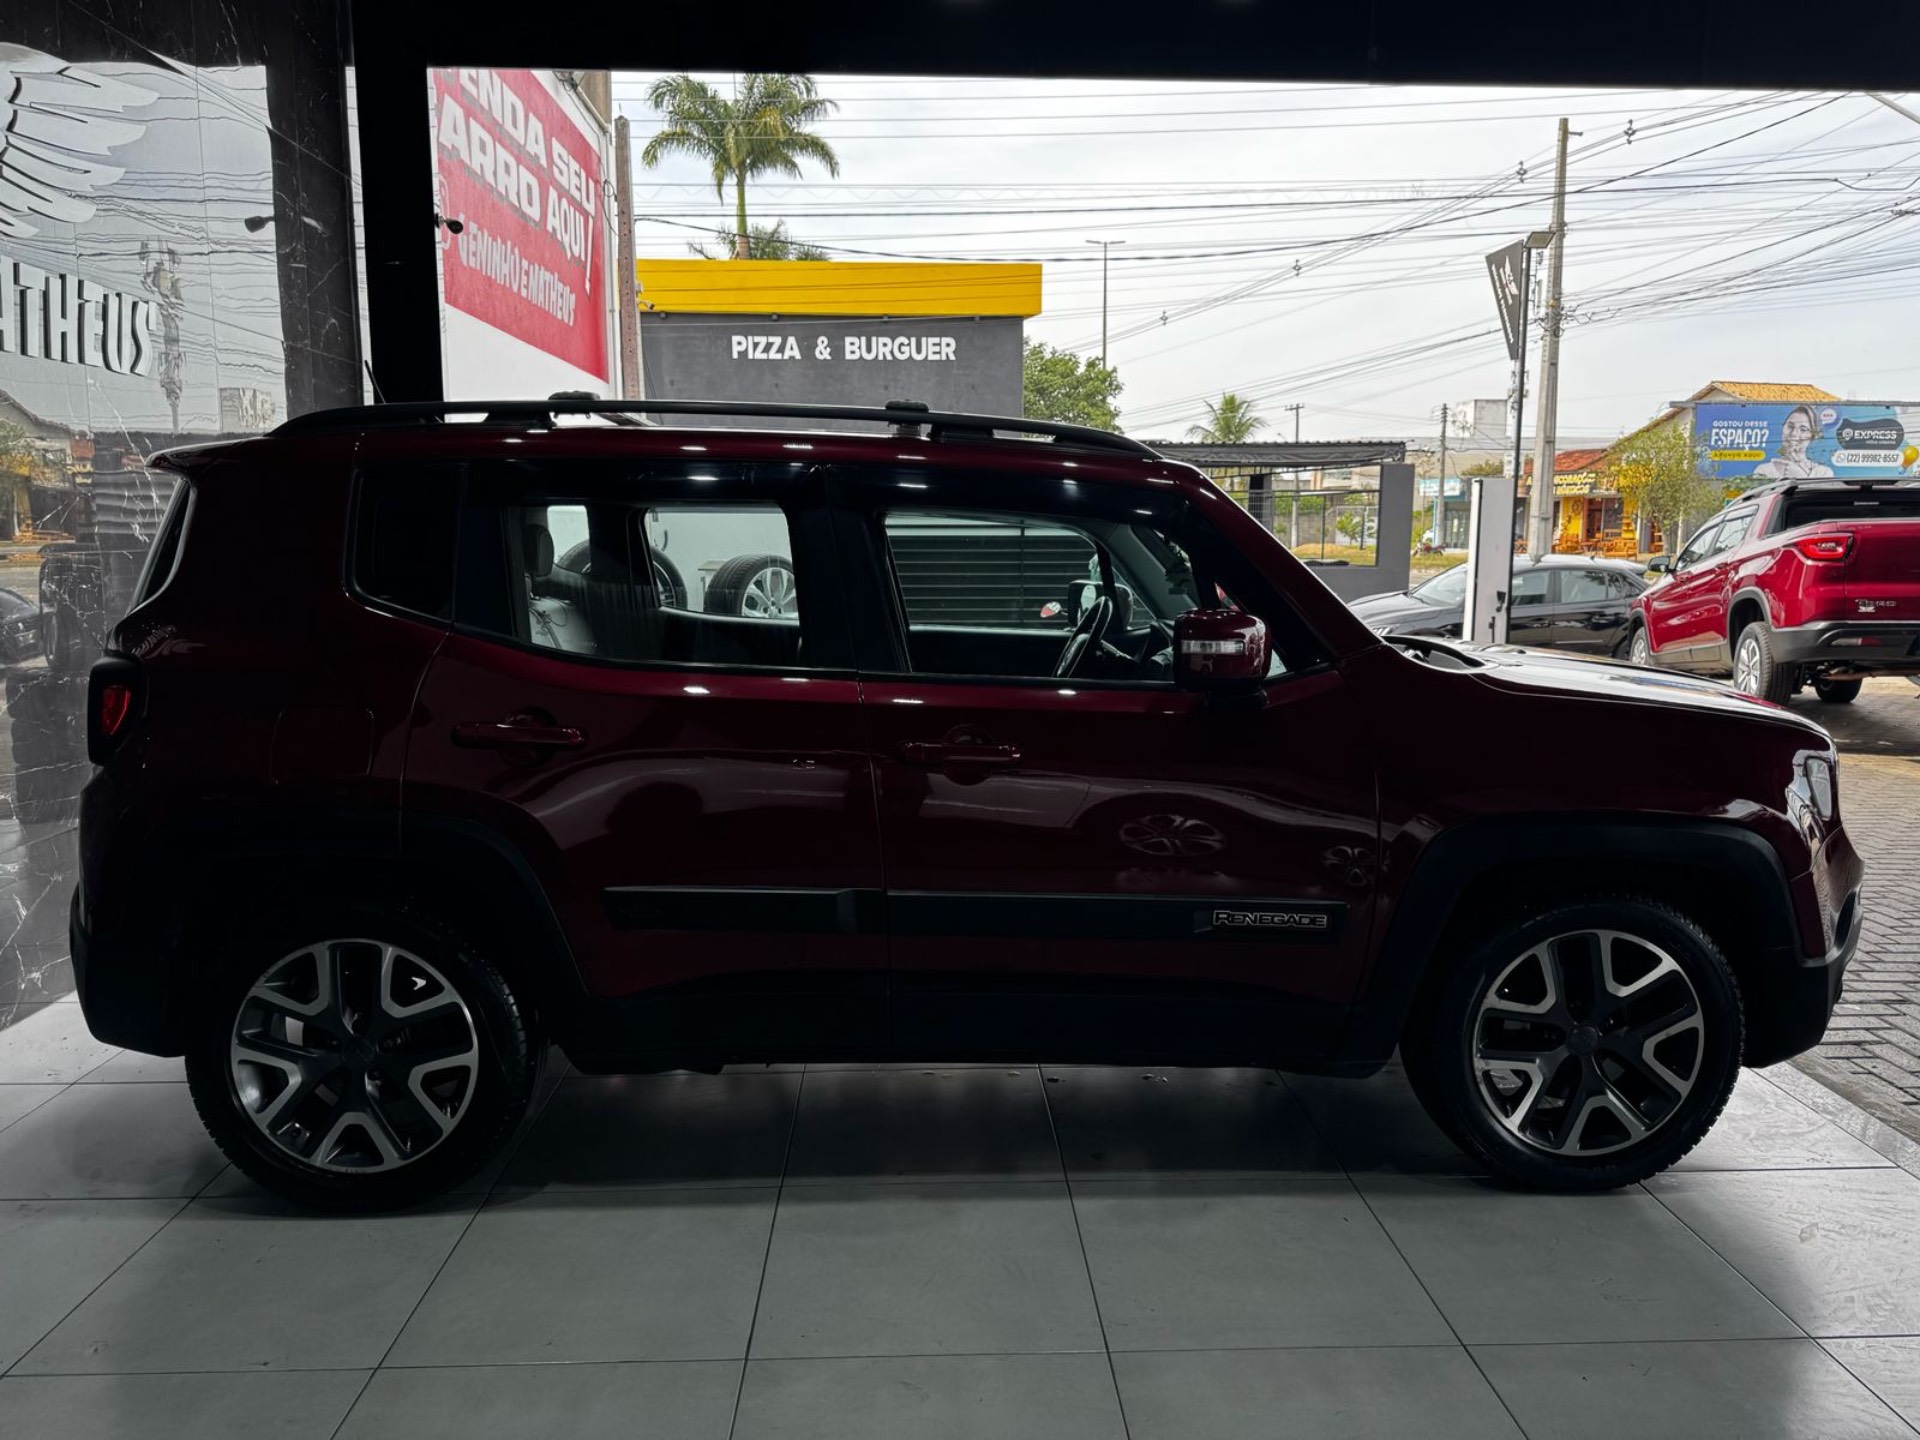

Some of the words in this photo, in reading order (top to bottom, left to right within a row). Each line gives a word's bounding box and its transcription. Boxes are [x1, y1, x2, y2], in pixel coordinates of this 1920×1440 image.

[551, 137, 596, 217] SEU
[520, 257, 529, 299] E
[528, 262, 576, 327] MATHEUS
[731, 335, 802, 360] PIZZA
[814, 335, 832, 361] &
[844, 336, 957, 361] BURGUER
[1712, 420, 1743, 428] GOSTOU
[1744, 420, 1768, 428] DESSE
[1710, 428, 1769, 450] ESPAÇO?
[1853, 430, 1897, 440] EXPRESS
[1846, 453, 1860, 463] (22)
[1213, 910, 1328, 929] RENEGADE
